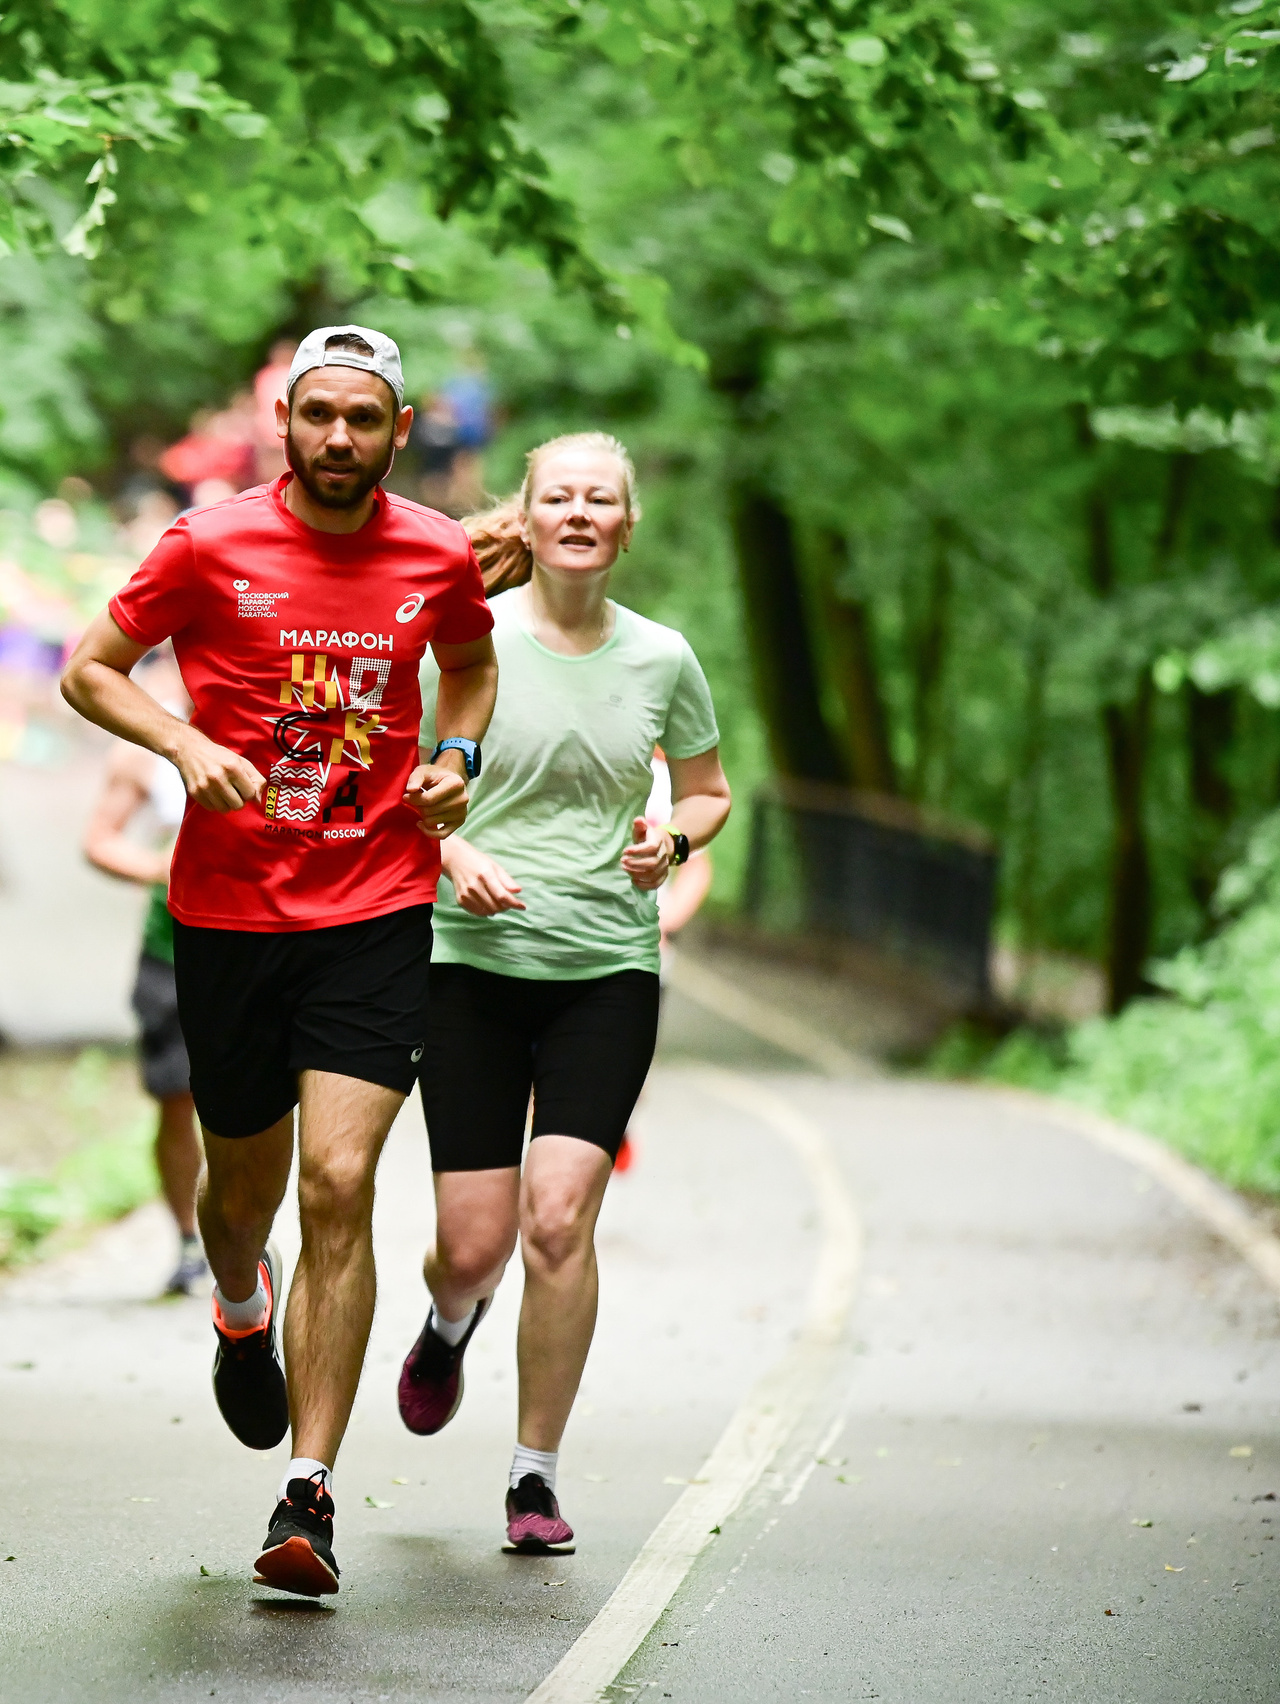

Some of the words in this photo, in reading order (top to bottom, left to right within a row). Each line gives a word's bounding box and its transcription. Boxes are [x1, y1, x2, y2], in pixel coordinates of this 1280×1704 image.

[237, 591, 289, 599] МОСКОВСКИЙ
[279, 629, 394, 651] МАРАФОН
[265, 786, 278, 819] 2022
[264, 823, 323, 839] MARATHON
[323, 828, 366, 840] MOSCOW
